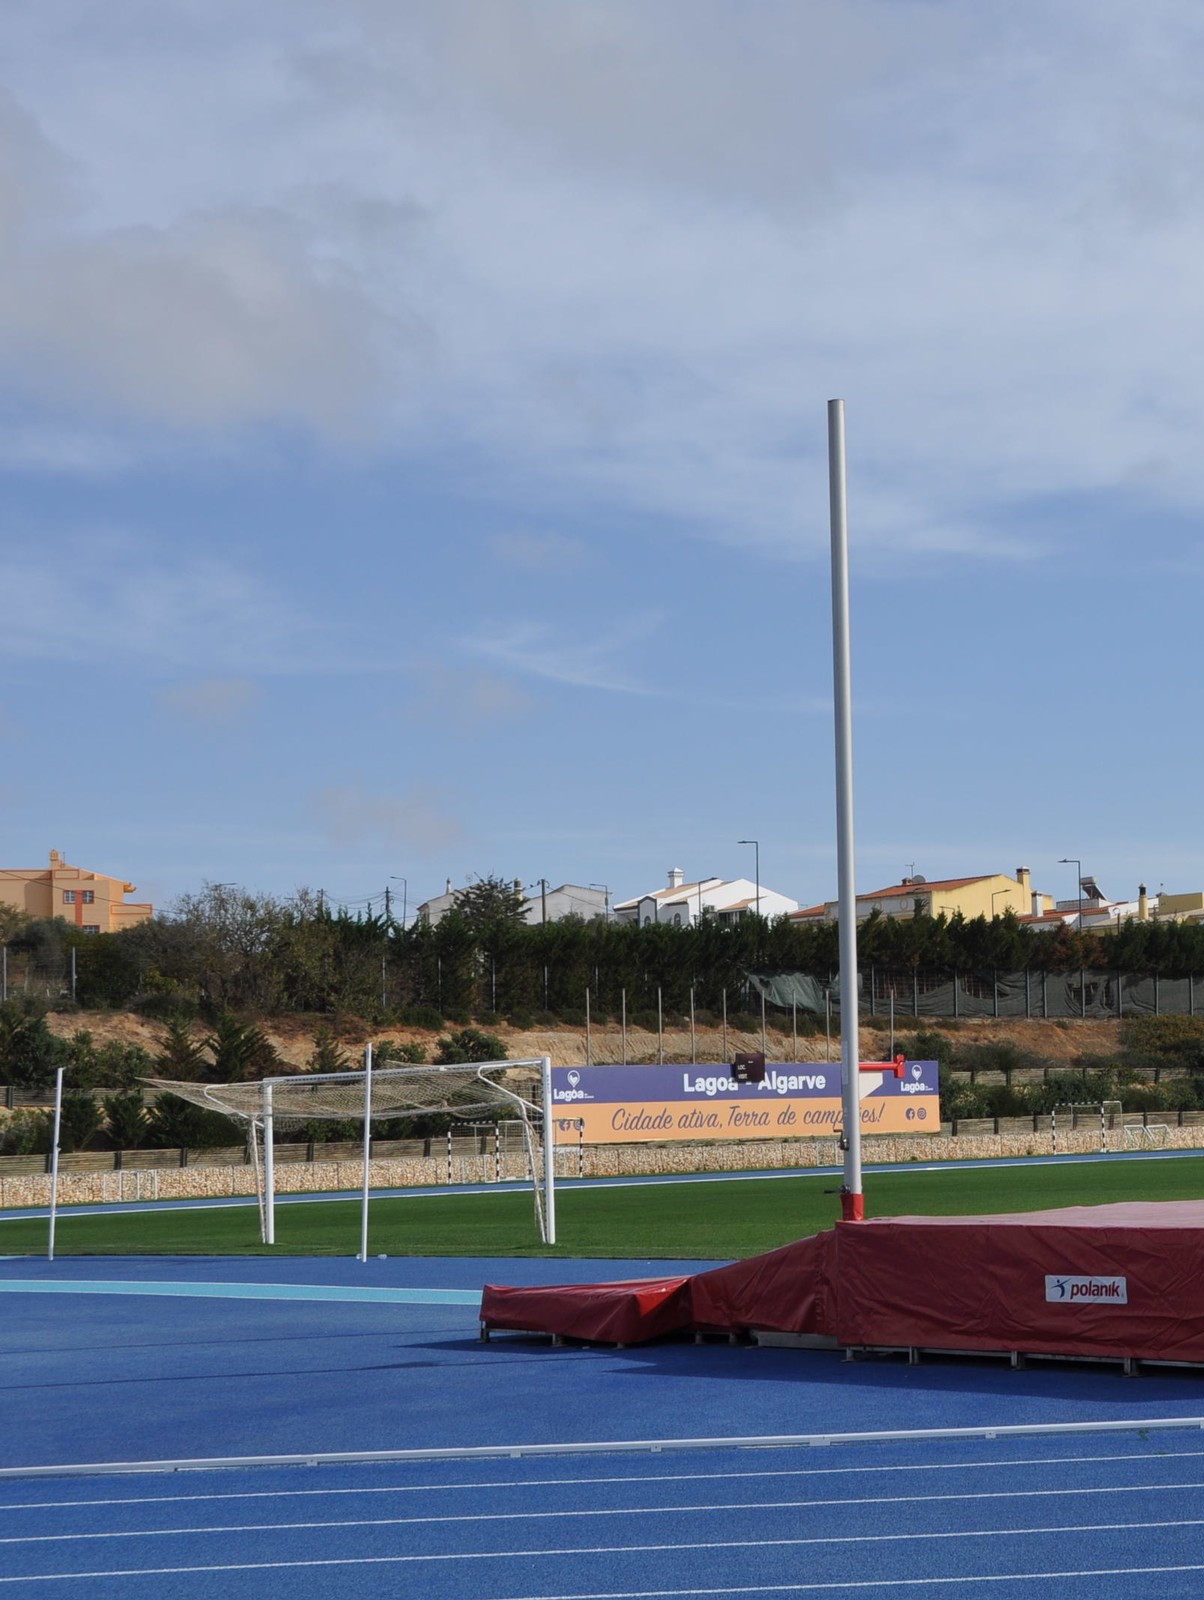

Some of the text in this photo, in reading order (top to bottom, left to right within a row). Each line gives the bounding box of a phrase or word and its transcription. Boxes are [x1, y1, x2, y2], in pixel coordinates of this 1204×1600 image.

[683, 1073, 738, 1095] Lagoa
[757, 1071, 826, 1094] Algarve
[901, 1081, 925, 1093] Lagoa
[553, 1088, 584, 1101] Lagoa
[612, 1102, 885, 1131] Cidade ativa, Terra de campes!
[1070, 1280, 1120, 1300] polanik
